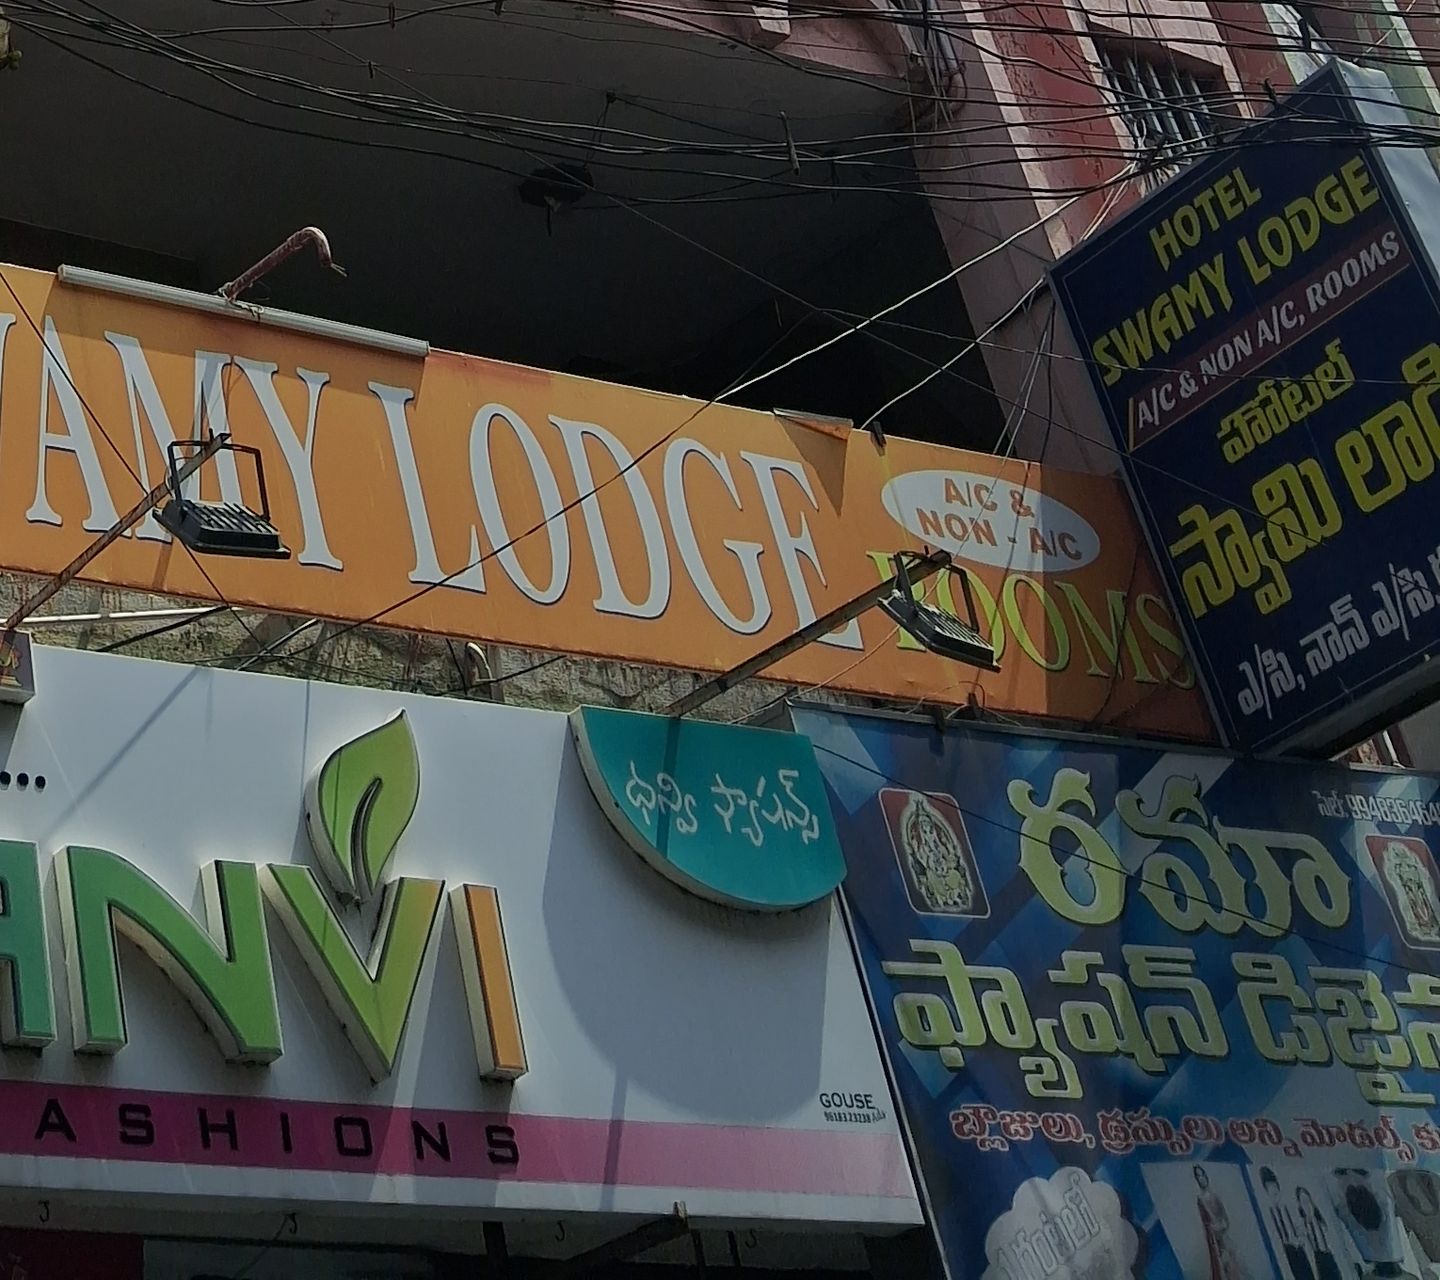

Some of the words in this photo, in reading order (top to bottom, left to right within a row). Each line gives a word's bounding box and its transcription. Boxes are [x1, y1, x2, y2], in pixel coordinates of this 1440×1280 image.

[1092, 252, 1234, 388] SWAMY
[1236, 155, 1381, 286] LODGE
[1149, 167, 1262, 272] HOTEL
[1136, 381, 1176, 429] A/C
[1179, 370, 1199, 400] &
[1199, 329, 1253, 386] NON
[1305, 230, 1401, 315] ROOMS
[366, 381, 865, 649] LODGE
[916, 507, 998, 547] NON
[1029, 527, 1083, 561] A/C
[944, 478, 998, 512] A/C
[1010, 489, 1034, 519] &
[819, 1092, 876, 1109] GOUSE
